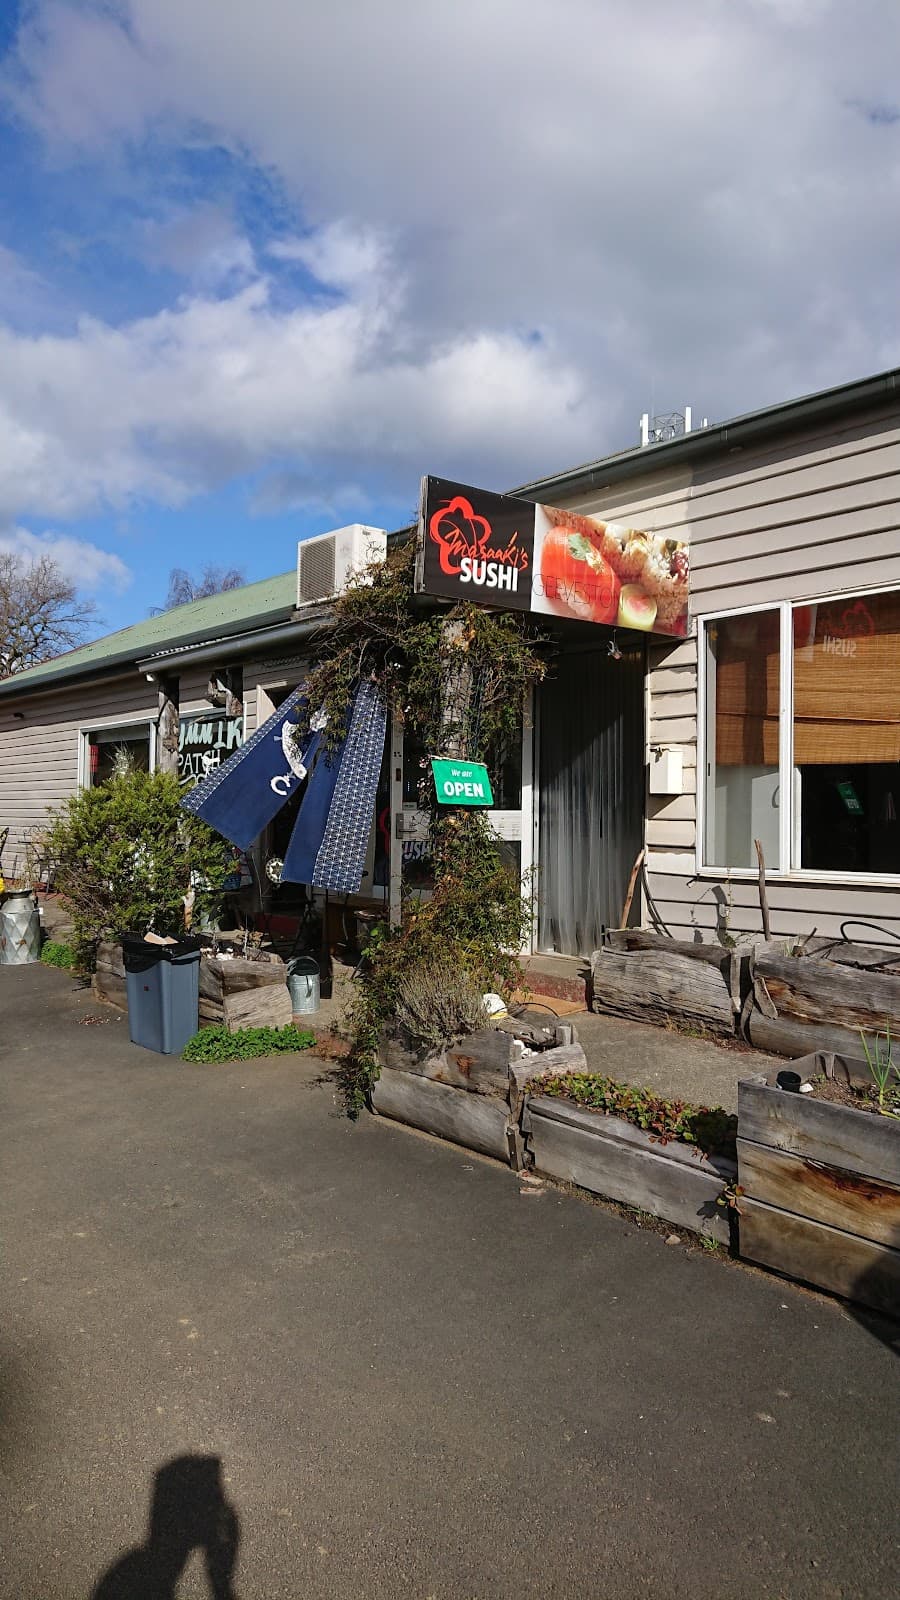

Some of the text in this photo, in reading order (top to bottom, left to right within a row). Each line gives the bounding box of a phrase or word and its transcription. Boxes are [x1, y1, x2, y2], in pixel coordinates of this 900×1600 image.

[459, 557, 519, 592] SUSHI
[451, 768, 473, 778] We are
[443, 780, 485, 798] OPEN
